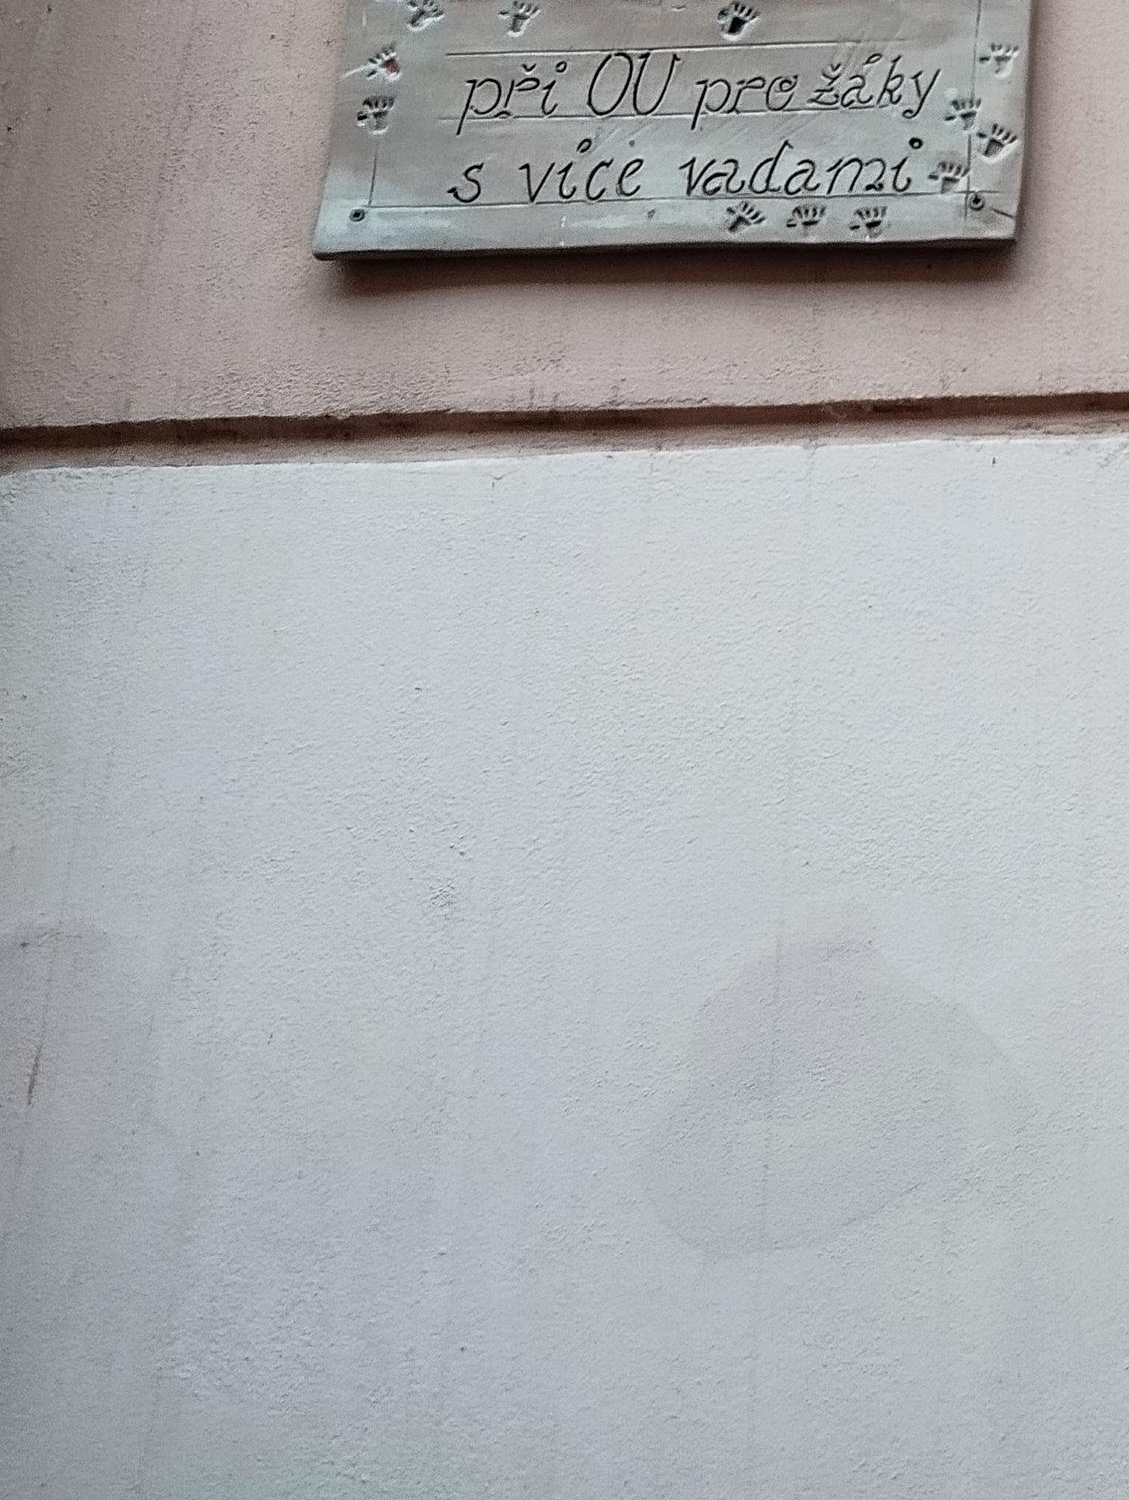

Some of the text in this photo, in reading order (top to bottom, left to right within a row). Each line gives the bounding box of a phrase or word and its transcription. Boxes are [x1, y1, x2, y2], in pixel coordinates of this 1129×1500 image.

[456, 51, 942, 136] při OU pro žáky
[678, 136, 925, 197] vadami
